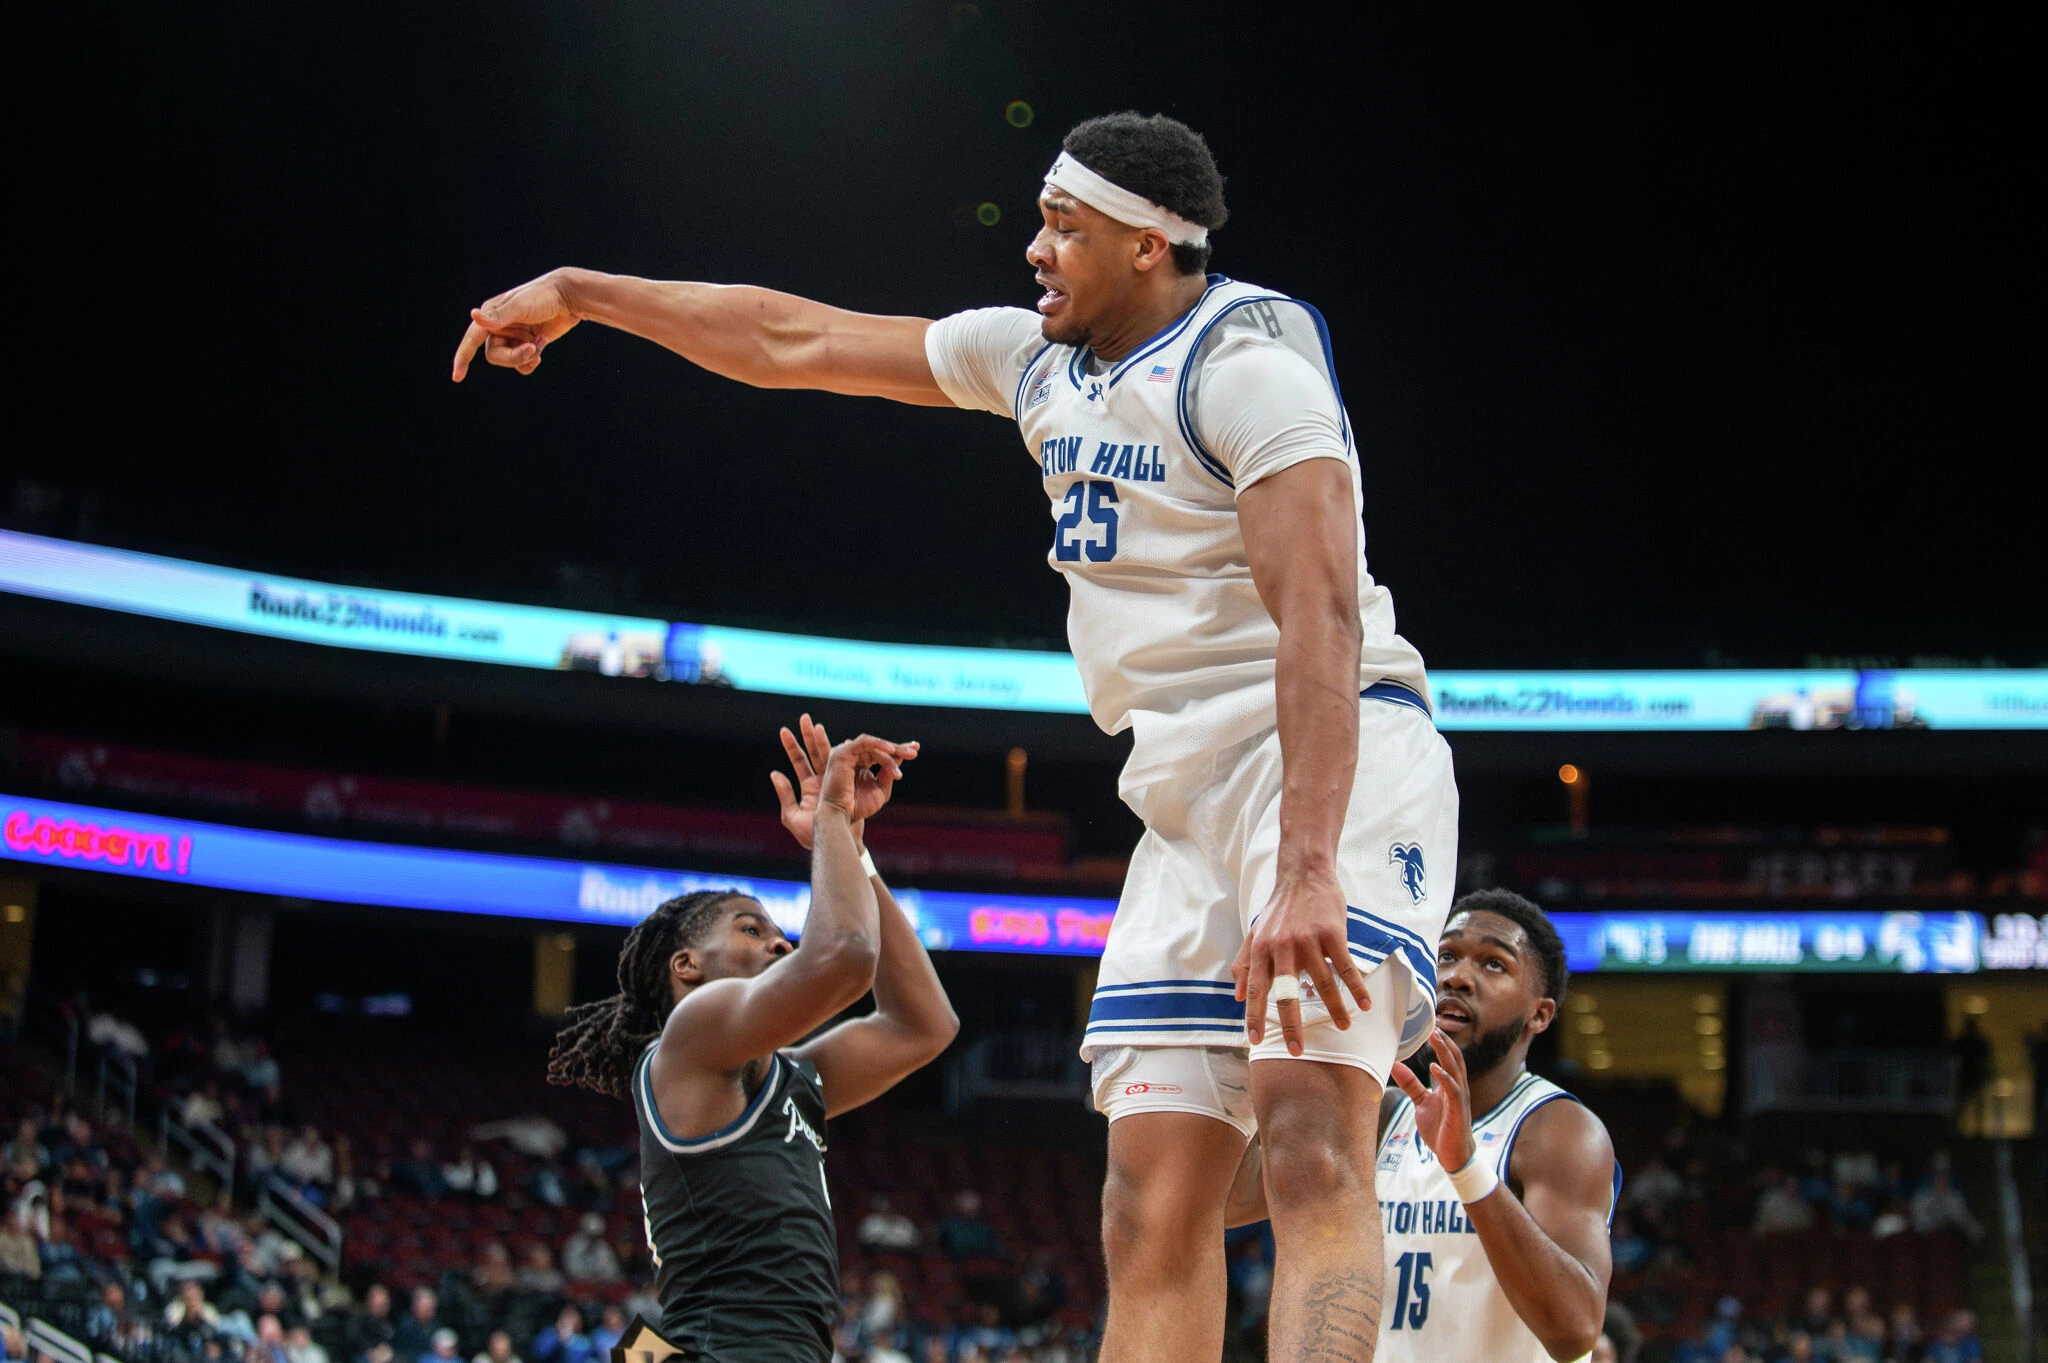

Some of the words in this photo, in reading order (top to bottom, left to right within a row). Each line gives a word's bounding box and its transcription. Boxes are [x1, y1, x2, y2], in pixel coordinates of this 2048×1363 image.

[1090, 441, 1165, 482] HALL
[1056, 480, 1120, 563] 25
[1379, 1201, 1419, 1234] TON
[1390, 1251, 1434, 1331] 15
